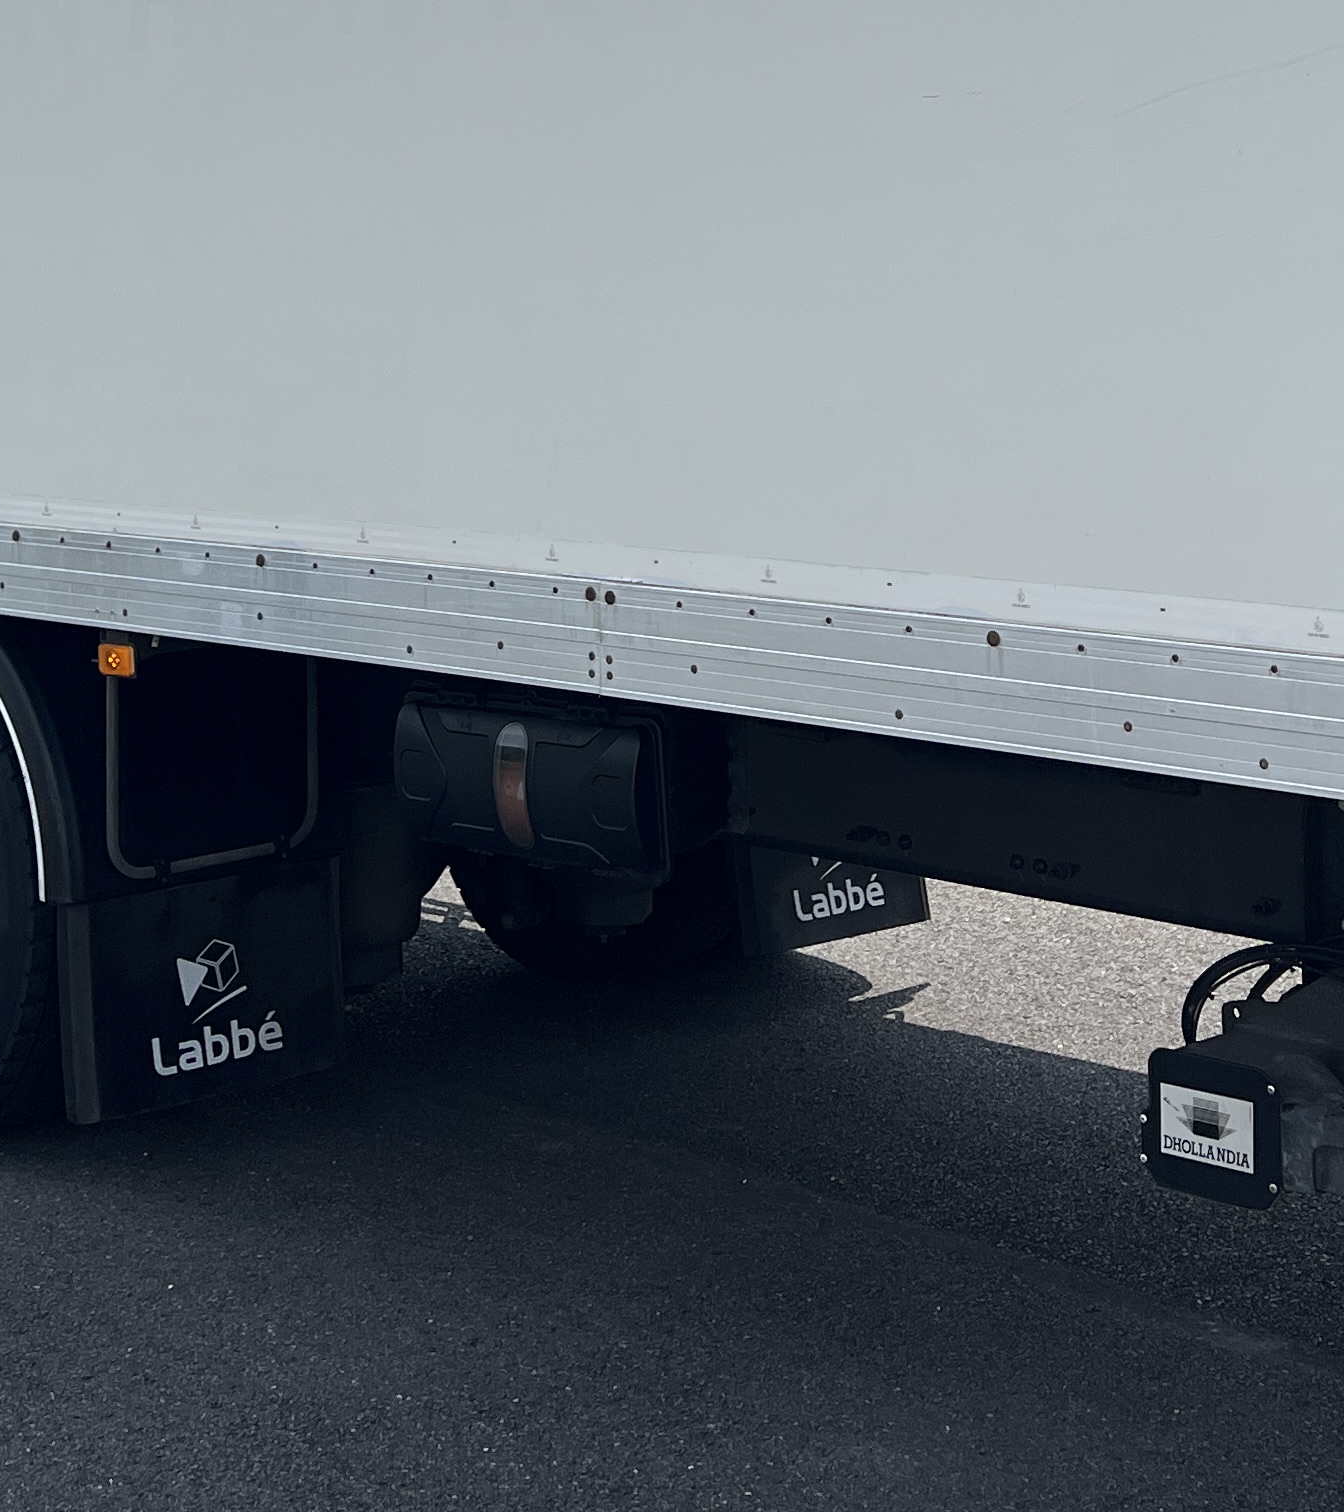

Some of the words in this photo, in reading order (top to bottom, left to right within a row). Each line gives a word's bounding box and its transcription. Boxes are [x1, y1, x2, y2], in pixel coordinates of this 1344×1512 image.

[792, 873, 886, 922] Labbé
[150, 1010, 284, 1078] Labbé
[1162, 1133, 1251, 1170] DHOLLANDIA
